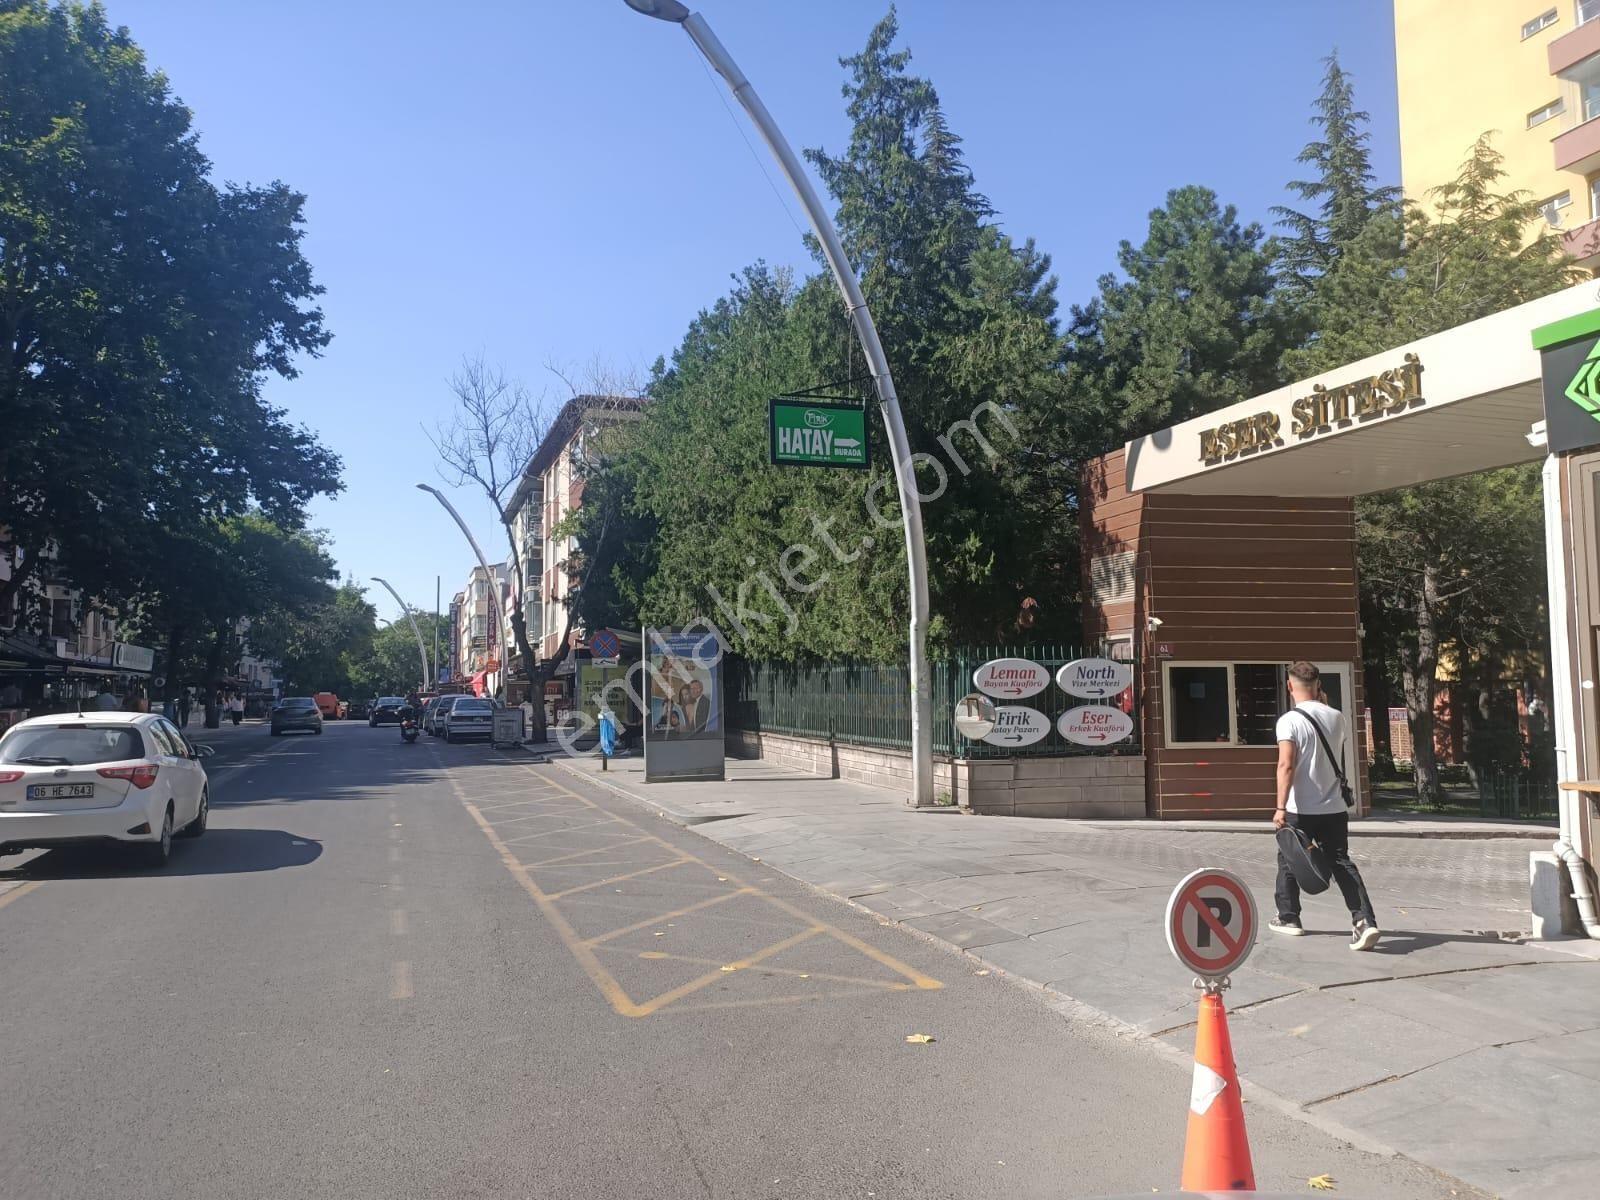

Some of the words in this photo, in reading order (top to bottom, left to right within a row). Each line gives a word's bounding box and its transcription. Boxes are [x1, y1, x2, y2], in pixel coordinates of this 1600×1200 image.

[778, 427, 834, 456] HATAY
[1198, 410, 1284, 466] ESER
[834, 447, 862, 457] BURADA
[990, 666, 1037, 680] Leman
[1076, 665, 1116, 680] North
[984, 680, 1009, 689] Bayan
[1010, 679, 1043, 689] Kuaförü
[1090, 679, 1120, 687] Merkezi
[998, 711, 1031, 726] Firik
[1081, 711, 1112, 725] Eser
[1013, 725, 1040, 734] Pazarı
[1069, 724, 1092, 732] Erkek
[1093, 724, 1125, 733] Kuaförü
[34, 787, 46, 797] 06
[52, 786, 65, 796] HE
[69, 785, 91, 795] 7643
